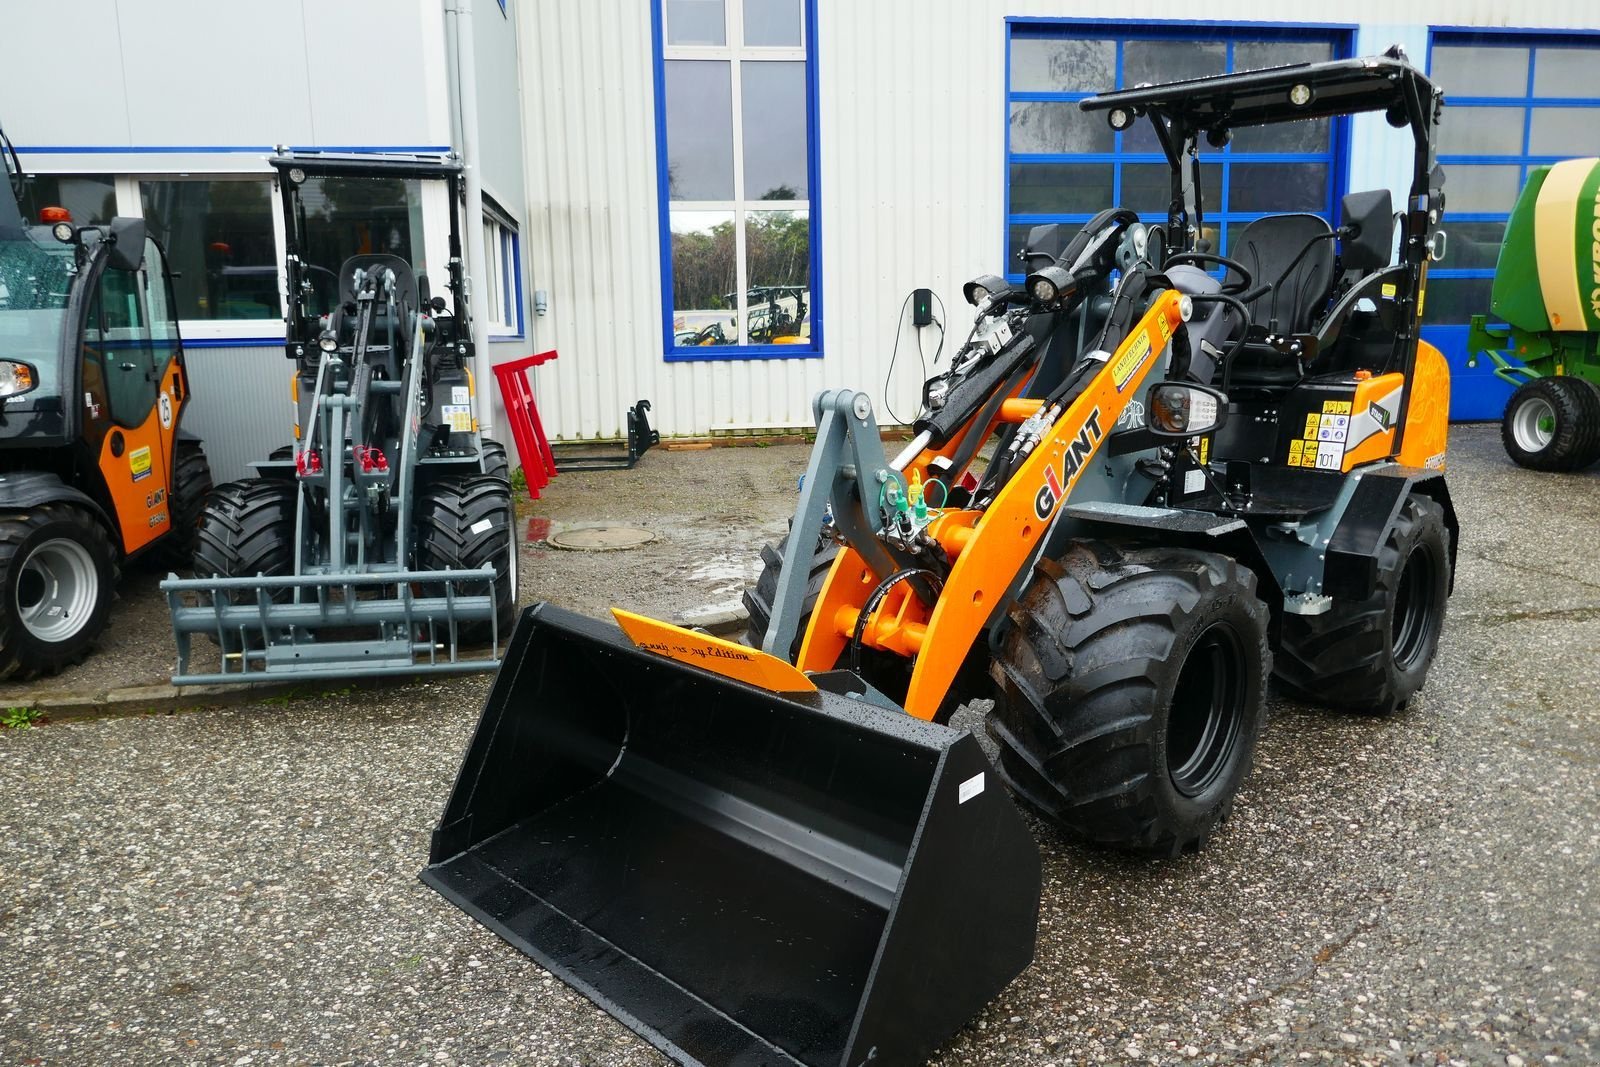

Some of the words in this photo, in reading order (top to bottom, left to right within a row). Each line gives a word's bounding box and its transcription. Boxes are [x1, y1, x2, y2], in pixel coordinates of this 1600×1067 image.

[1112, 333, 1147, 377] LANDTECHNIK
[1319, 453, 1334, 468] 101
[706, 646, 755, 662] Edition
